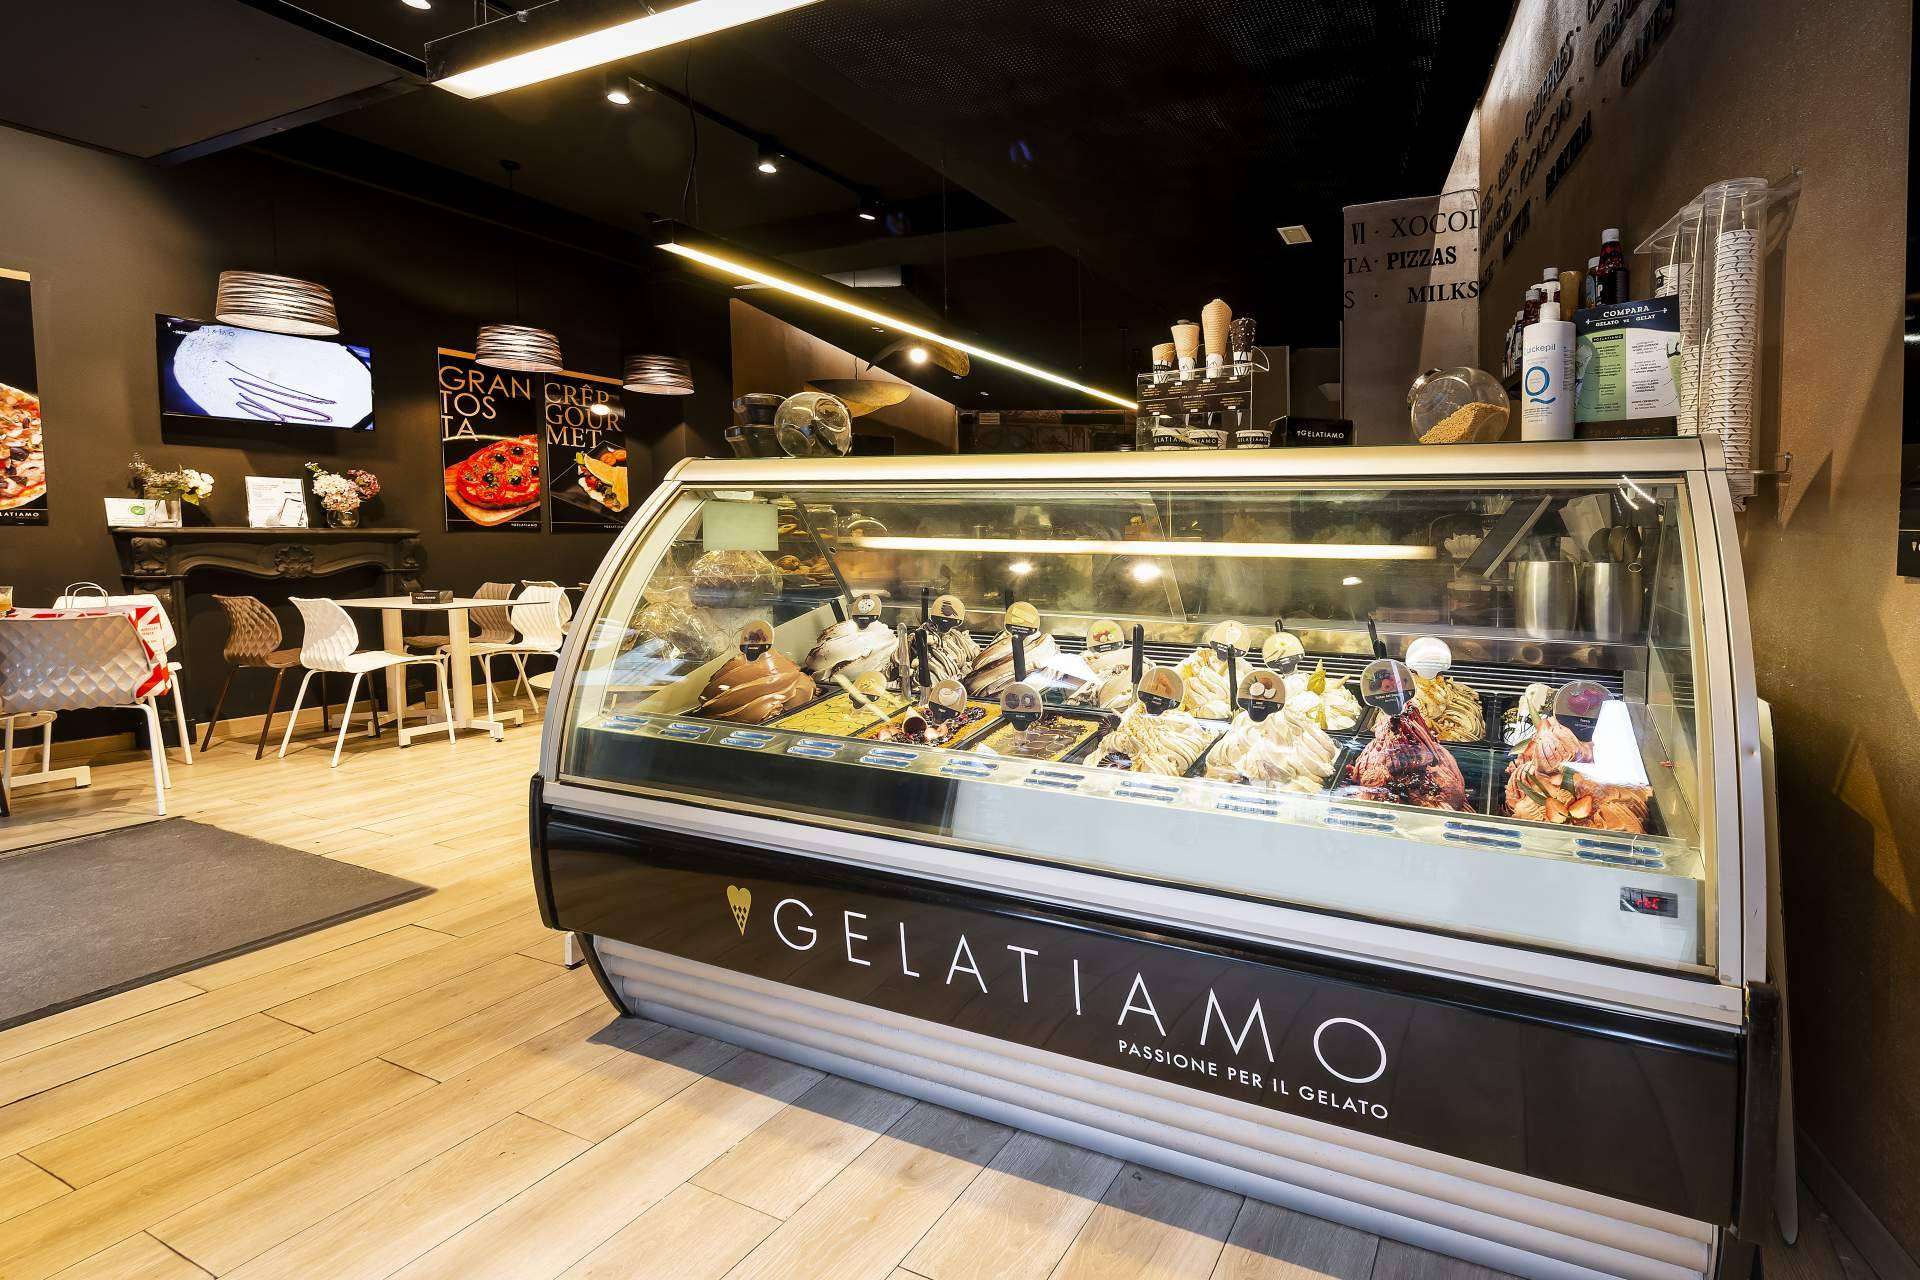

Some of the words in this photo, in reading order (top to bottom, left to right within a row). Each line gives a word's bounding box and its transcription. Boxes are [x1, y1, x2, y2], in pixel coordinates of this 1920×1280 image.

[1387, 245, 1457, 270] PIZZAS
[1595, 319, 1620, 327] GELATO
[1603, 305, 1650, 318] COMPARA
[439, 366, 531, 401] GRAN
[440, 390, 497, 420] TOS
[545, 403, 623, 432] GOUR
[441, 415, 479, 442] TA
[546, 423, 603, 449] MET
[1300, 430, 1345, 439] GELATIAMO
[773, 898, 1388, 1084] GELATIAMO
[1118, 1038, 1219, 1078] PASSIONE
[1227, 1066, 1263, 1089] PER
[1273, 1077, 1289, 1096] IL
[1298, 1084, 1390, 1120] GELATO
